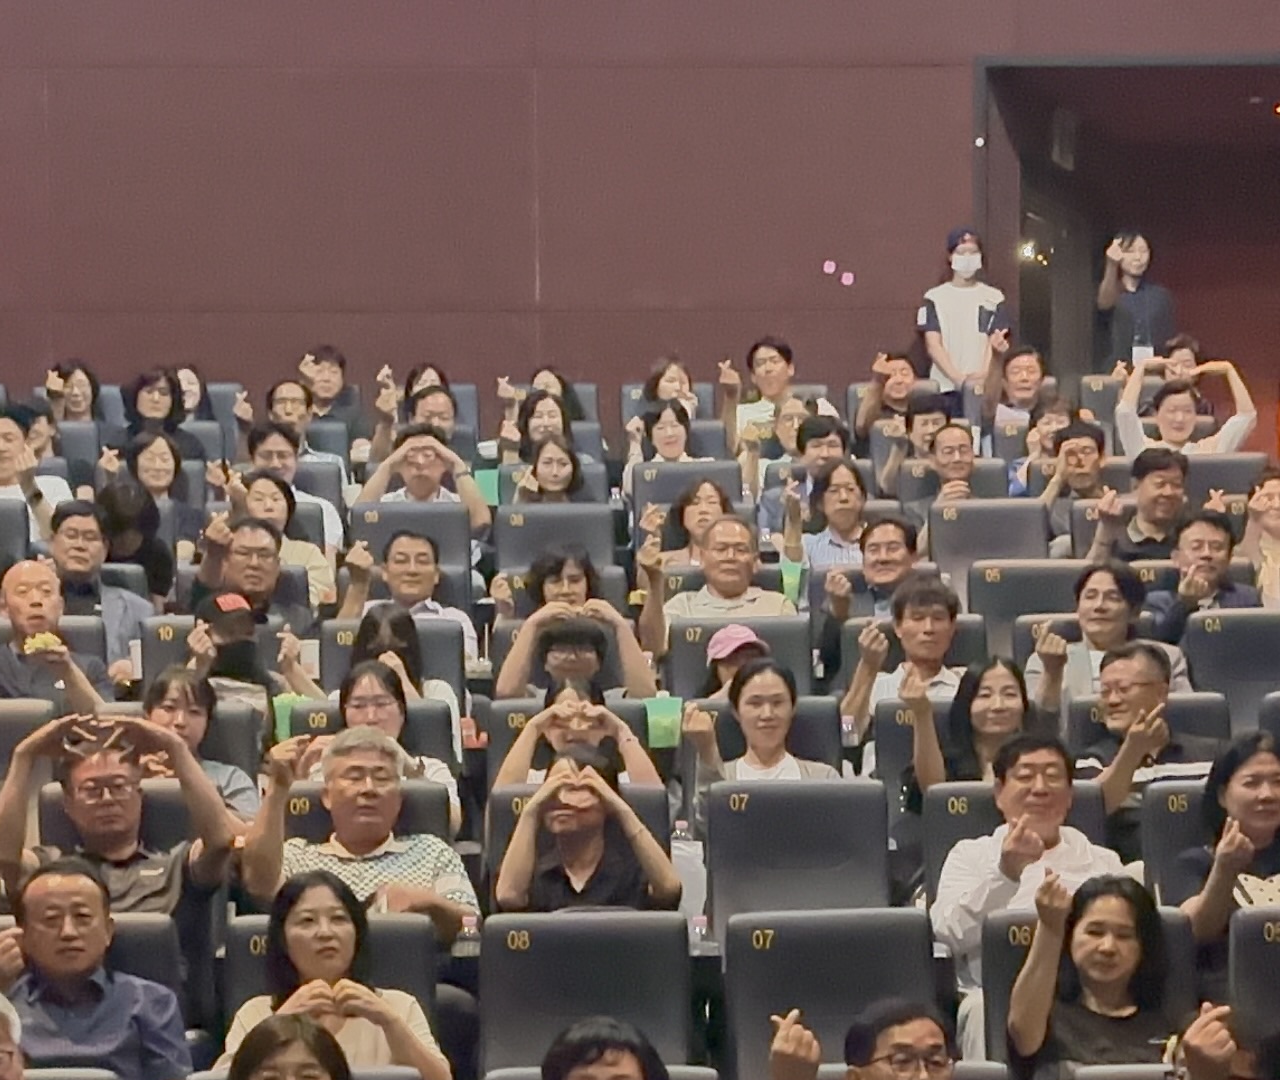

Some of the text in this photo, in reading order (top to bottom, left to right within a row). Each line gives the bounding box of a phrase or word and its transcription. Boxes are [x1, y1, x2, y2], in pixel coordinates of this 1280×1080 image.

[157, 624, 174, 641] 10
[1204, 617, 1223, 633] 04
[685, 626, 701, 644] 07
[308, 711, 328, 729] 09
[290, 796, 311, 816] 09
[729, 794, 750, 812] 07
[947, 796, 969, 815] 06
[1167, 793, 1189, 813] 05
[506, 929, 531, 950] 08
[752, 929, 775, 950] 07
[1008, 925, 1032, 946] 06
